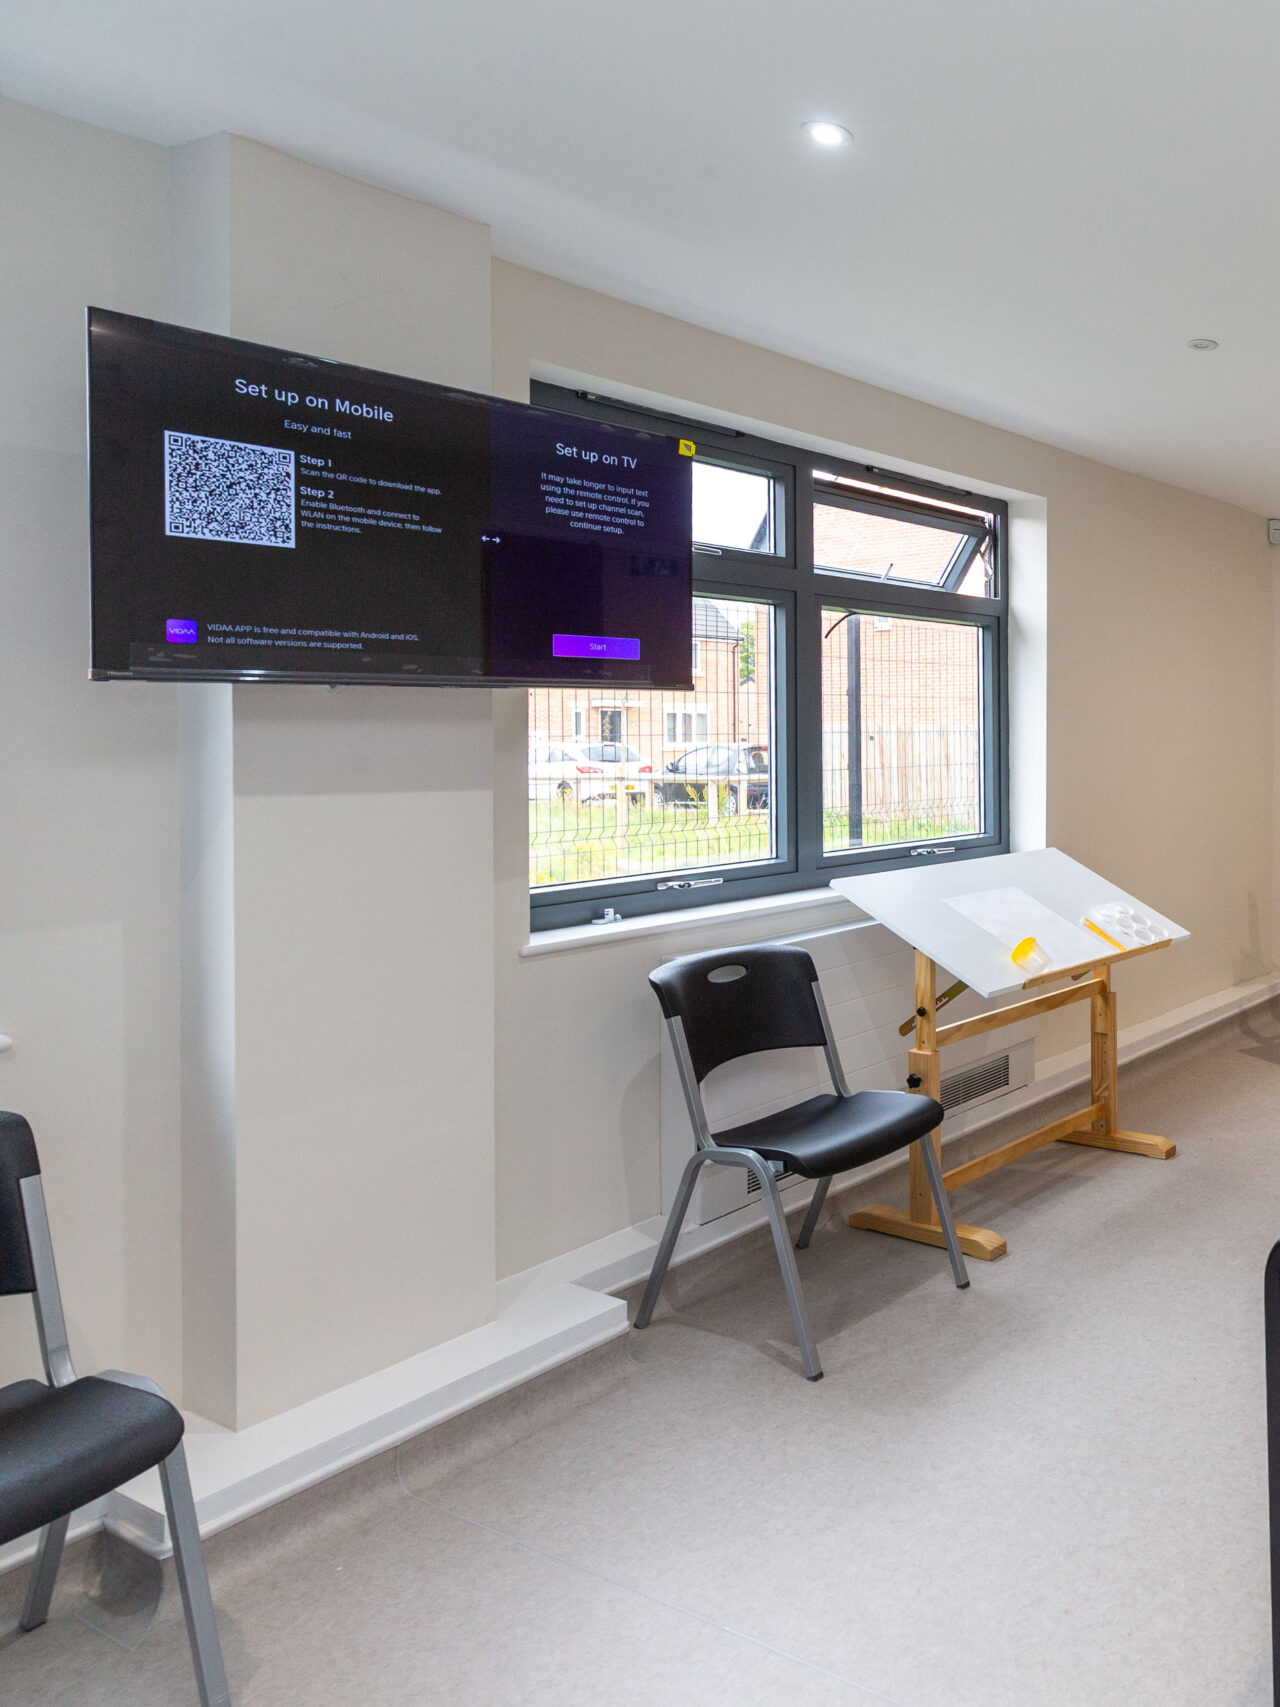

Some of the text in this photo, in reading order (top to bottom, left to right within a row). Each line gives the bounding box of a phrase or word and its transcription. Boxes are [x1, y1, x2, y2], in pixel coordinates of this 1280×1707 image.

[234, 378, 394, 422] Set up on Mobile
[284, 419, 352, 440] Easy and fast
[300, 454, 332, 467] Step 1
[556, 443, 637, 469] Set up on TV
[300, 467, 320, 477] Scan
[322, 471, 335, 479] the
[378, 480, 413, 491] download
[548, 474, 564, 484] may
[566, 476, 582, 485] take
[583, 480, 606, 490] longer
[616, 485, 634, 495] input
[635, 489, 648, 497] text
[300, 486, 334, 498] Step 2
[540, 484, 561, 494] using
[563, 487, 575, 495] the
[577, 490, 602, 500] remote
[636, 500, 649, 508] you
[301, 499, 328, 509] Enable
[329, 503, 365, 513] Bluetooth
[382, 511, 411, 519] connect
[545, 495, 564, 504] need
[575, 500, 586, 508] set
[587, 502, 597, 510] up
[599, 504, 626, 514] channel
[301, 510, 324, 519] WLAN
[352, 516, 377, 525] mobile
[405, 523, 420, 531] then
[422, 525, 442, 533] follow
[301, 520, 314, 528] the
[545, 506, 569, 515] please
[571, 510, 584, 518] use
[585, 512, 611, 521] remote
[612, 516, 636, 526] control
[570, 520, 601, 531] continue
[237, 637, 272, 646] software
[264, 626, 279, 634] free
[298, 629, 341, 638] compatible
[360, 632, 389, 640] Android
[589, 643, 606, 651] Start
